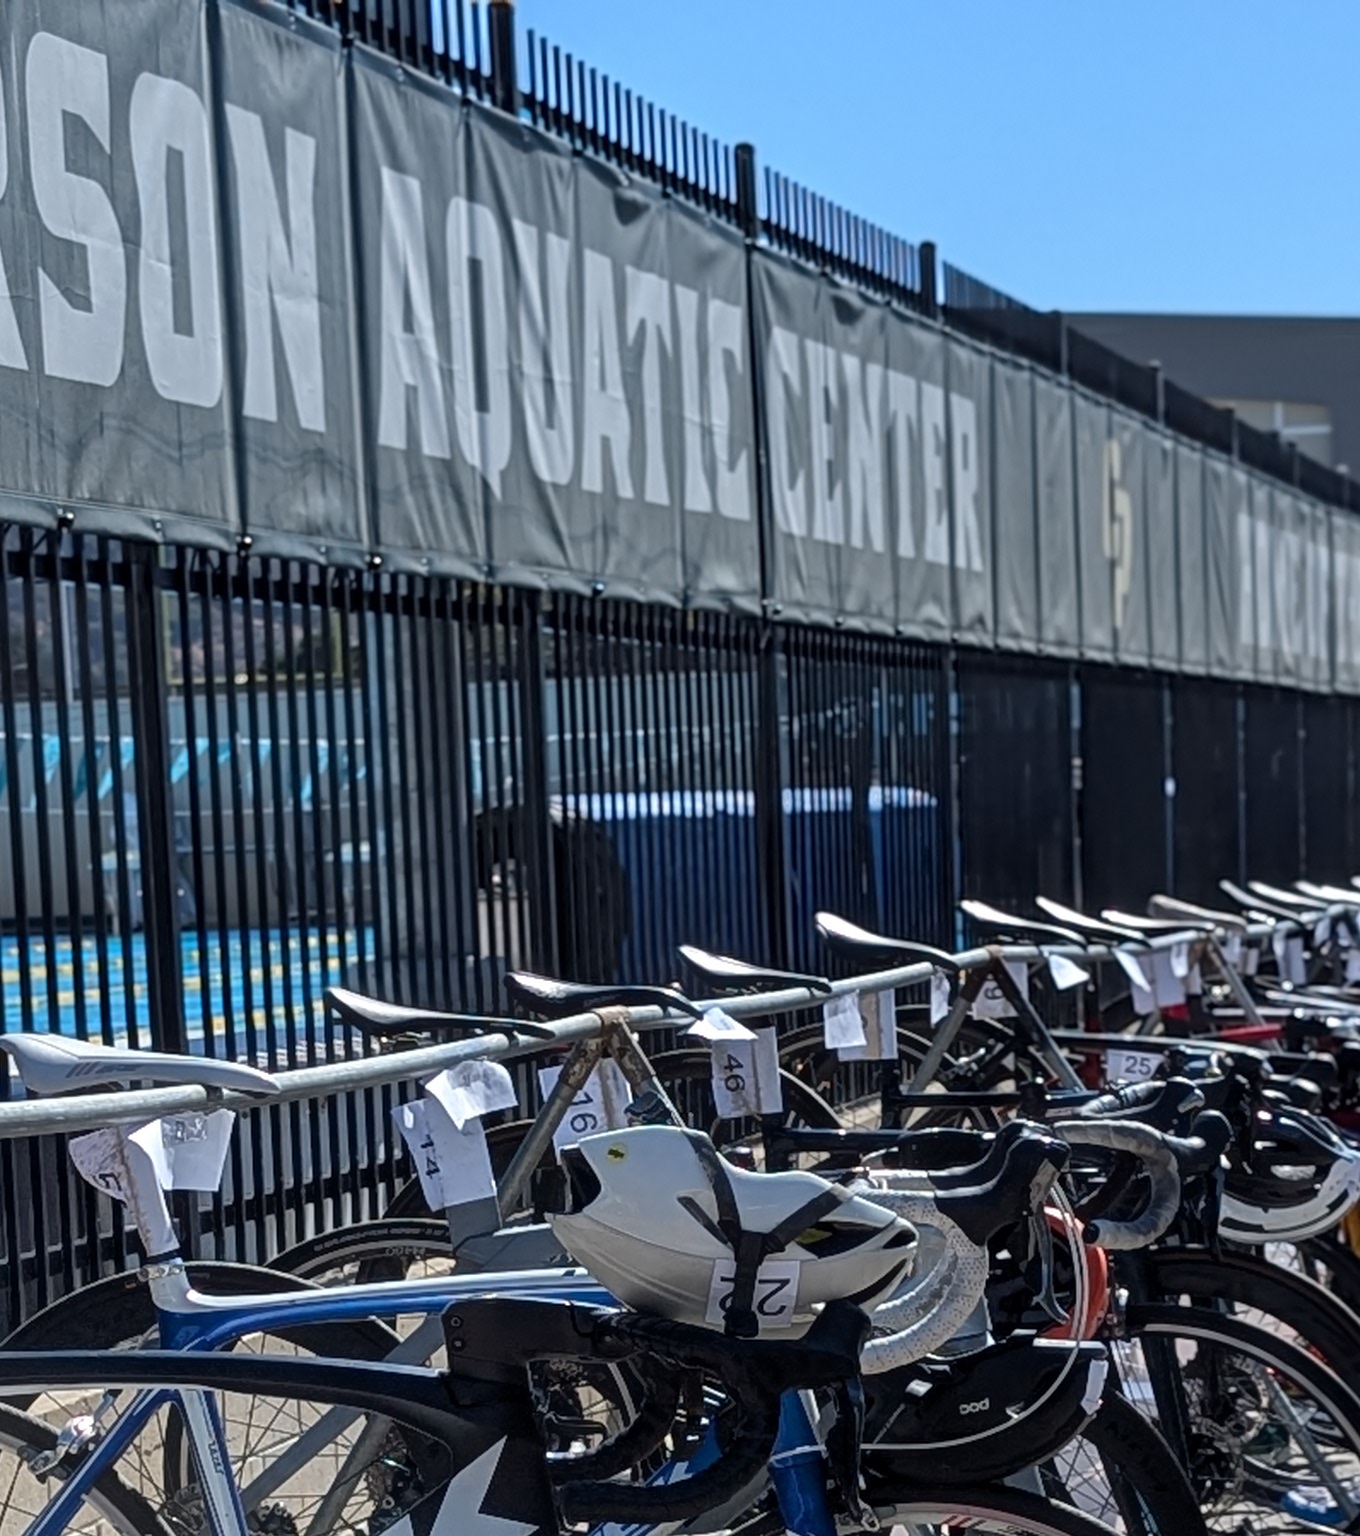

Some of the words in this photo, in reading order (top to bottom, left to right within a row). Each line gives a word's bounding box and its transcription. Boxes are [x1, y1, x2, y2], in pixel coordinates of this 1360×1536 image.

[377, 165, 752, 522] AQUATIC
[765, 327, 985, 573] CENTER
[723, 1053, 747, 1094] 46
[1123, 1055, 1152, 1076] 25
[568, 1092, 599, 1135] 16
[417, 1134, 443, 1180] 14
